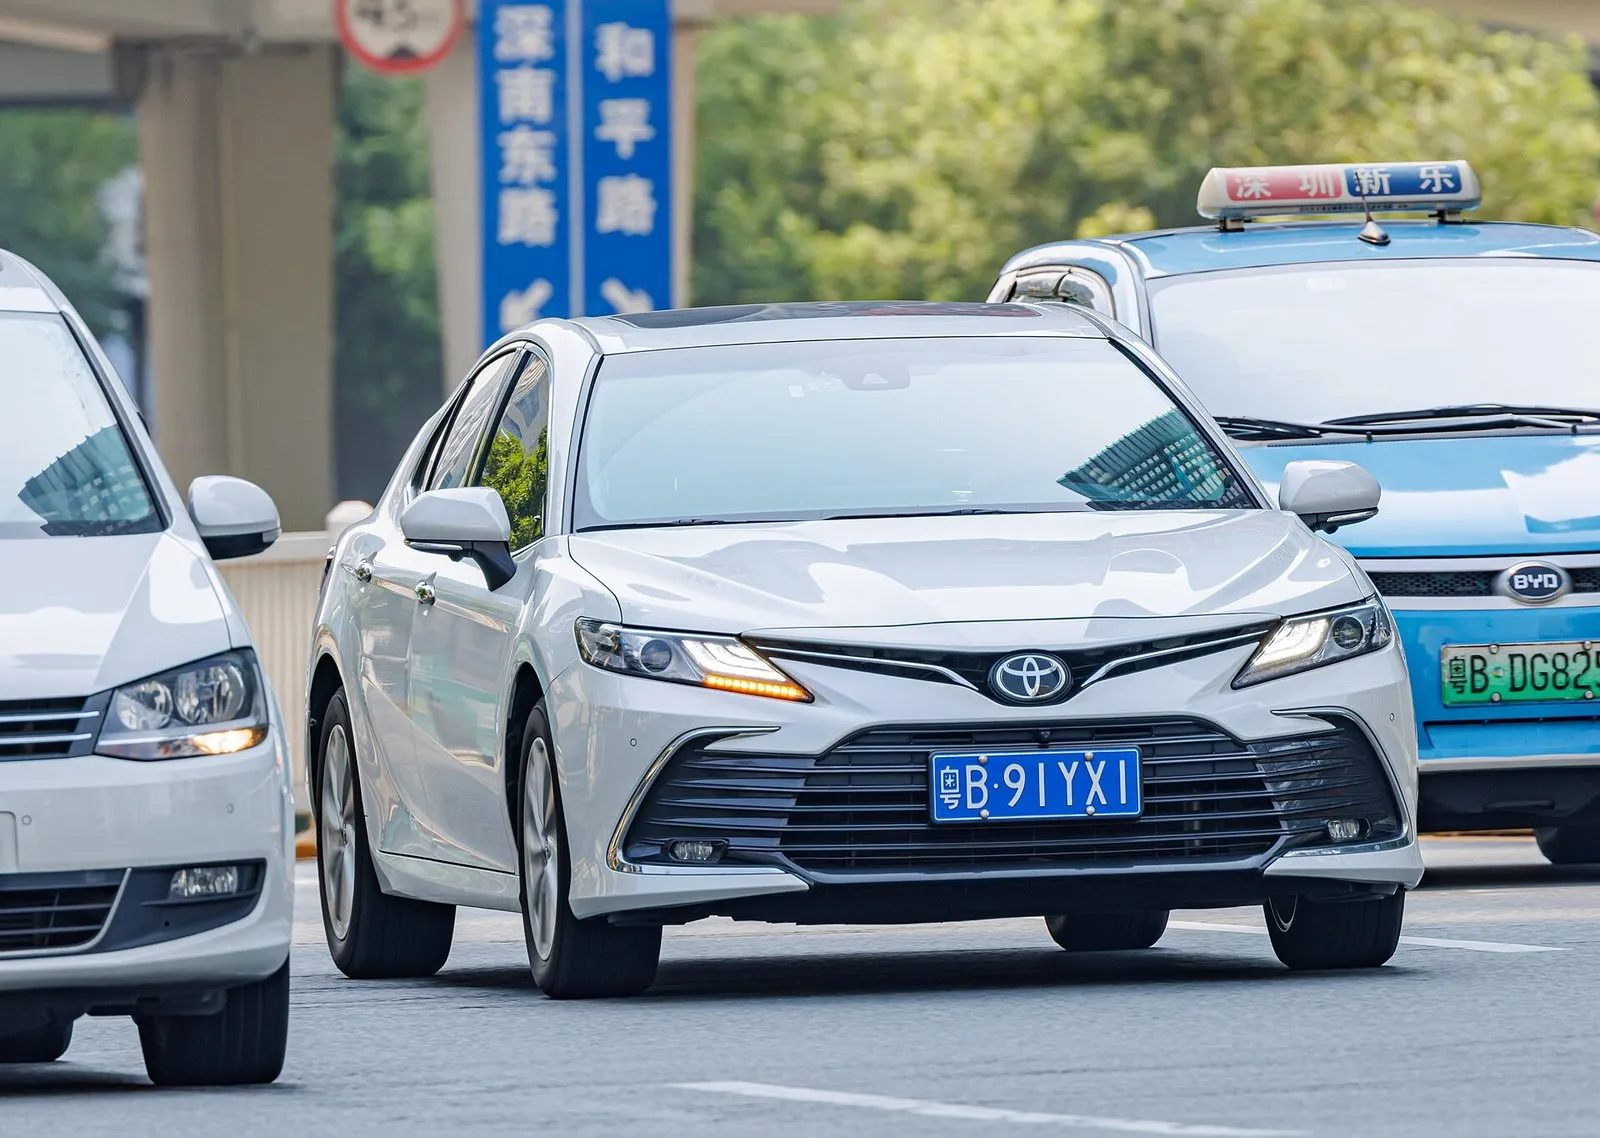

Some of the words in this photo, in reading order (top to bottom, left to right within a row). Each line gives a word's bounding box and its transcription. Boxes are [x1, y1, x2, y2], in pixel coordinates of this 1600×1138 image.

[495, 4, 558, 247] 深南东路
[595, 22, 656, 235] 和平路
[1514, 573, 1558, 589] BYD
